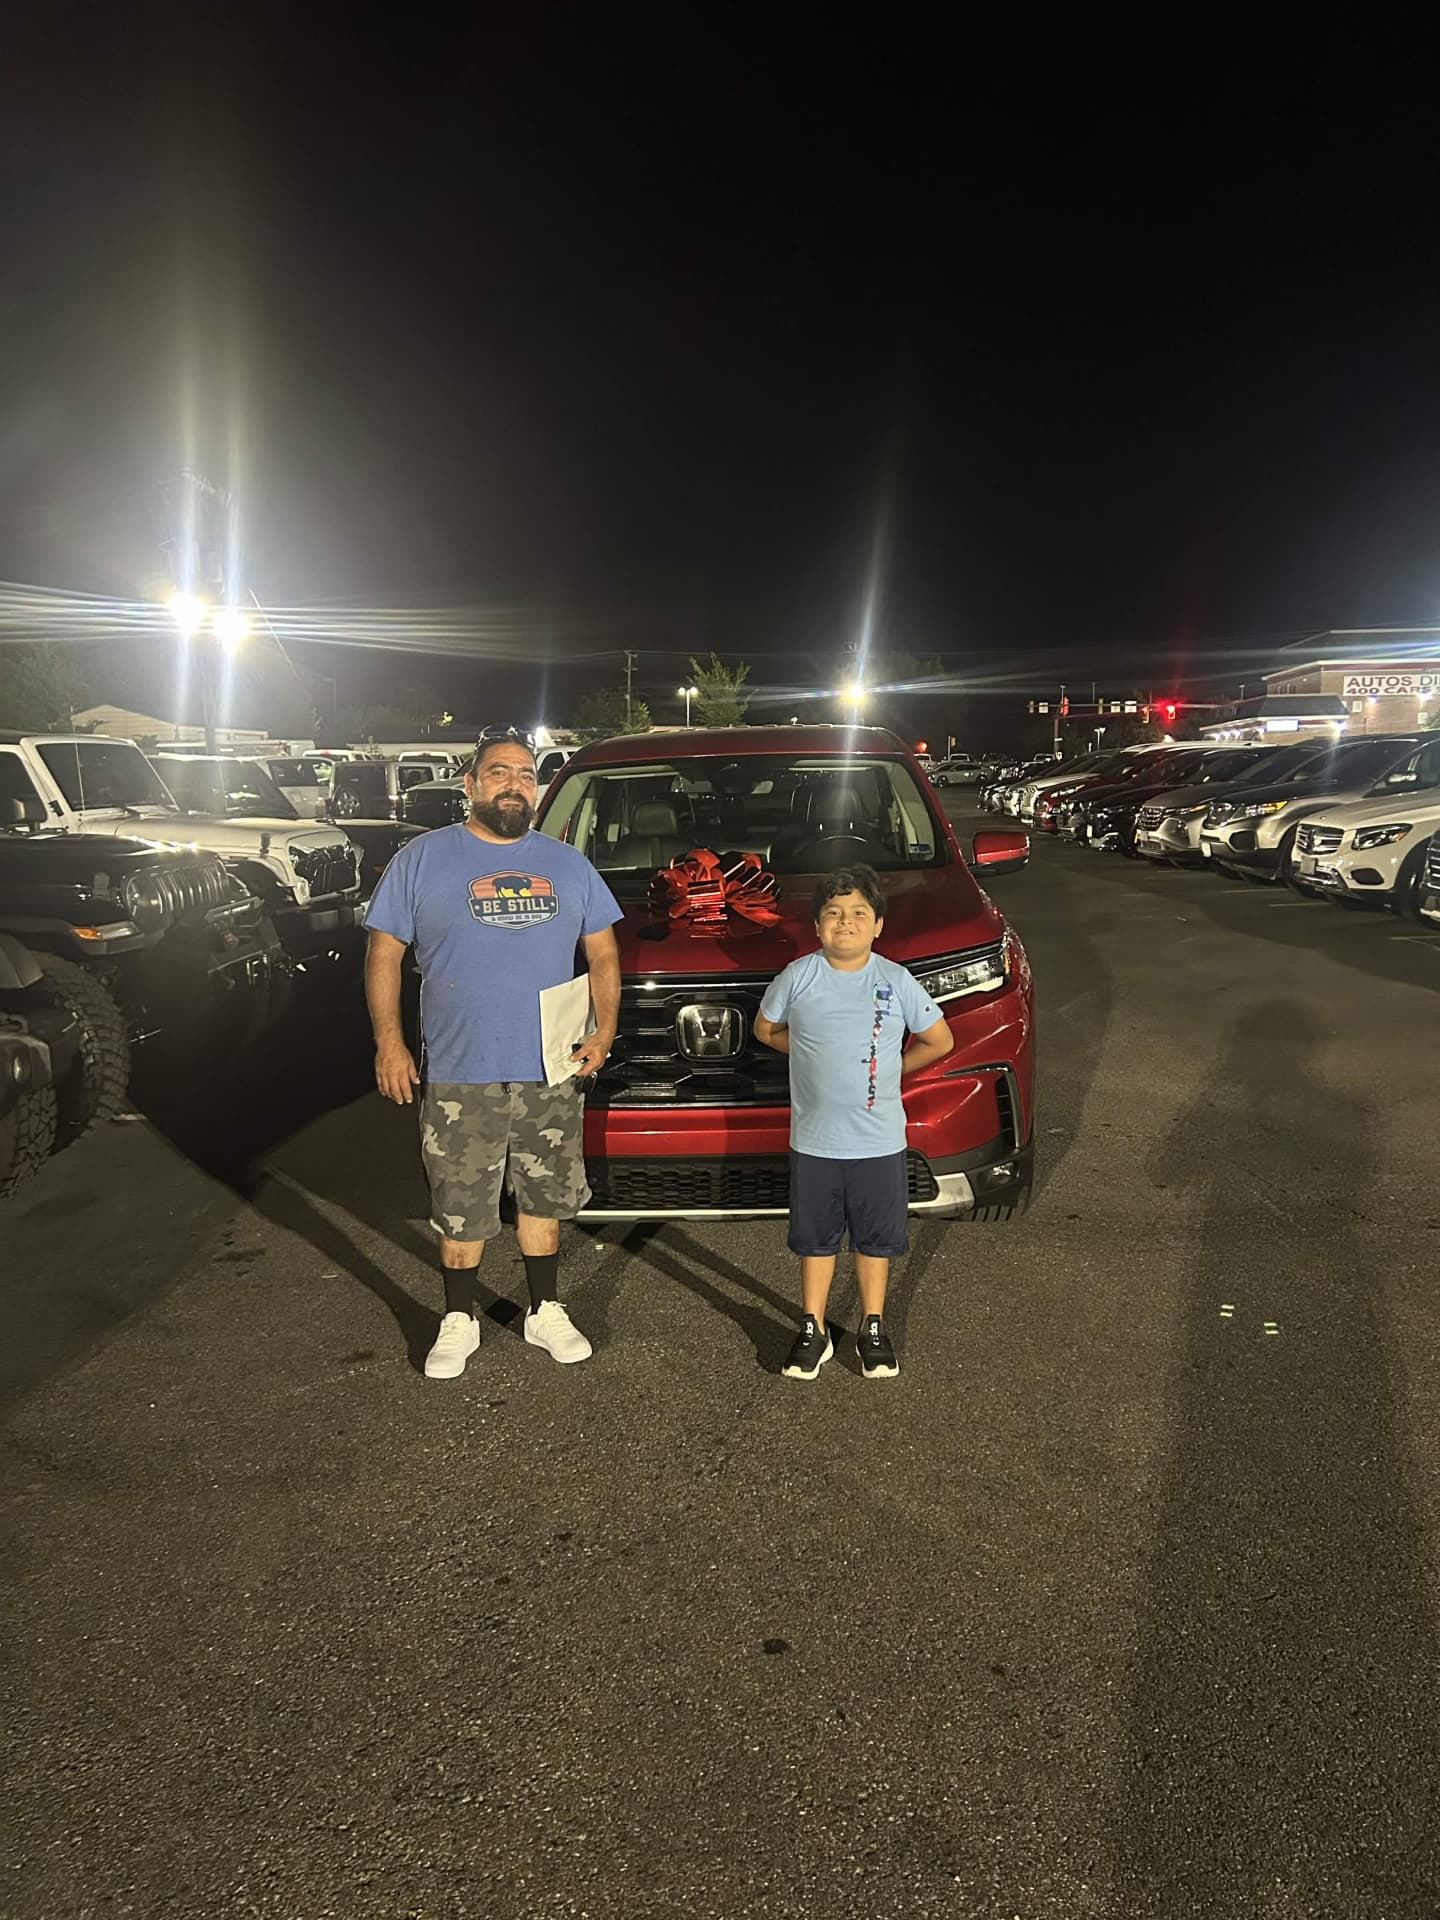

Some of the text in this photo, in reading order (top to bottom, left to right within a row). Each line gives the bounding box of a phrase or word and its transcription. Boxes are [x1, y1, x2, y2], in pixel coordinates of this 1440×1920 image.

[1347, 676, 1413, 687] AUTOS
[1346, 687, 1380, 695] 400
[1384, 686, 1431, 694] CARS
[482, 898, 550, 914] BE STILL
